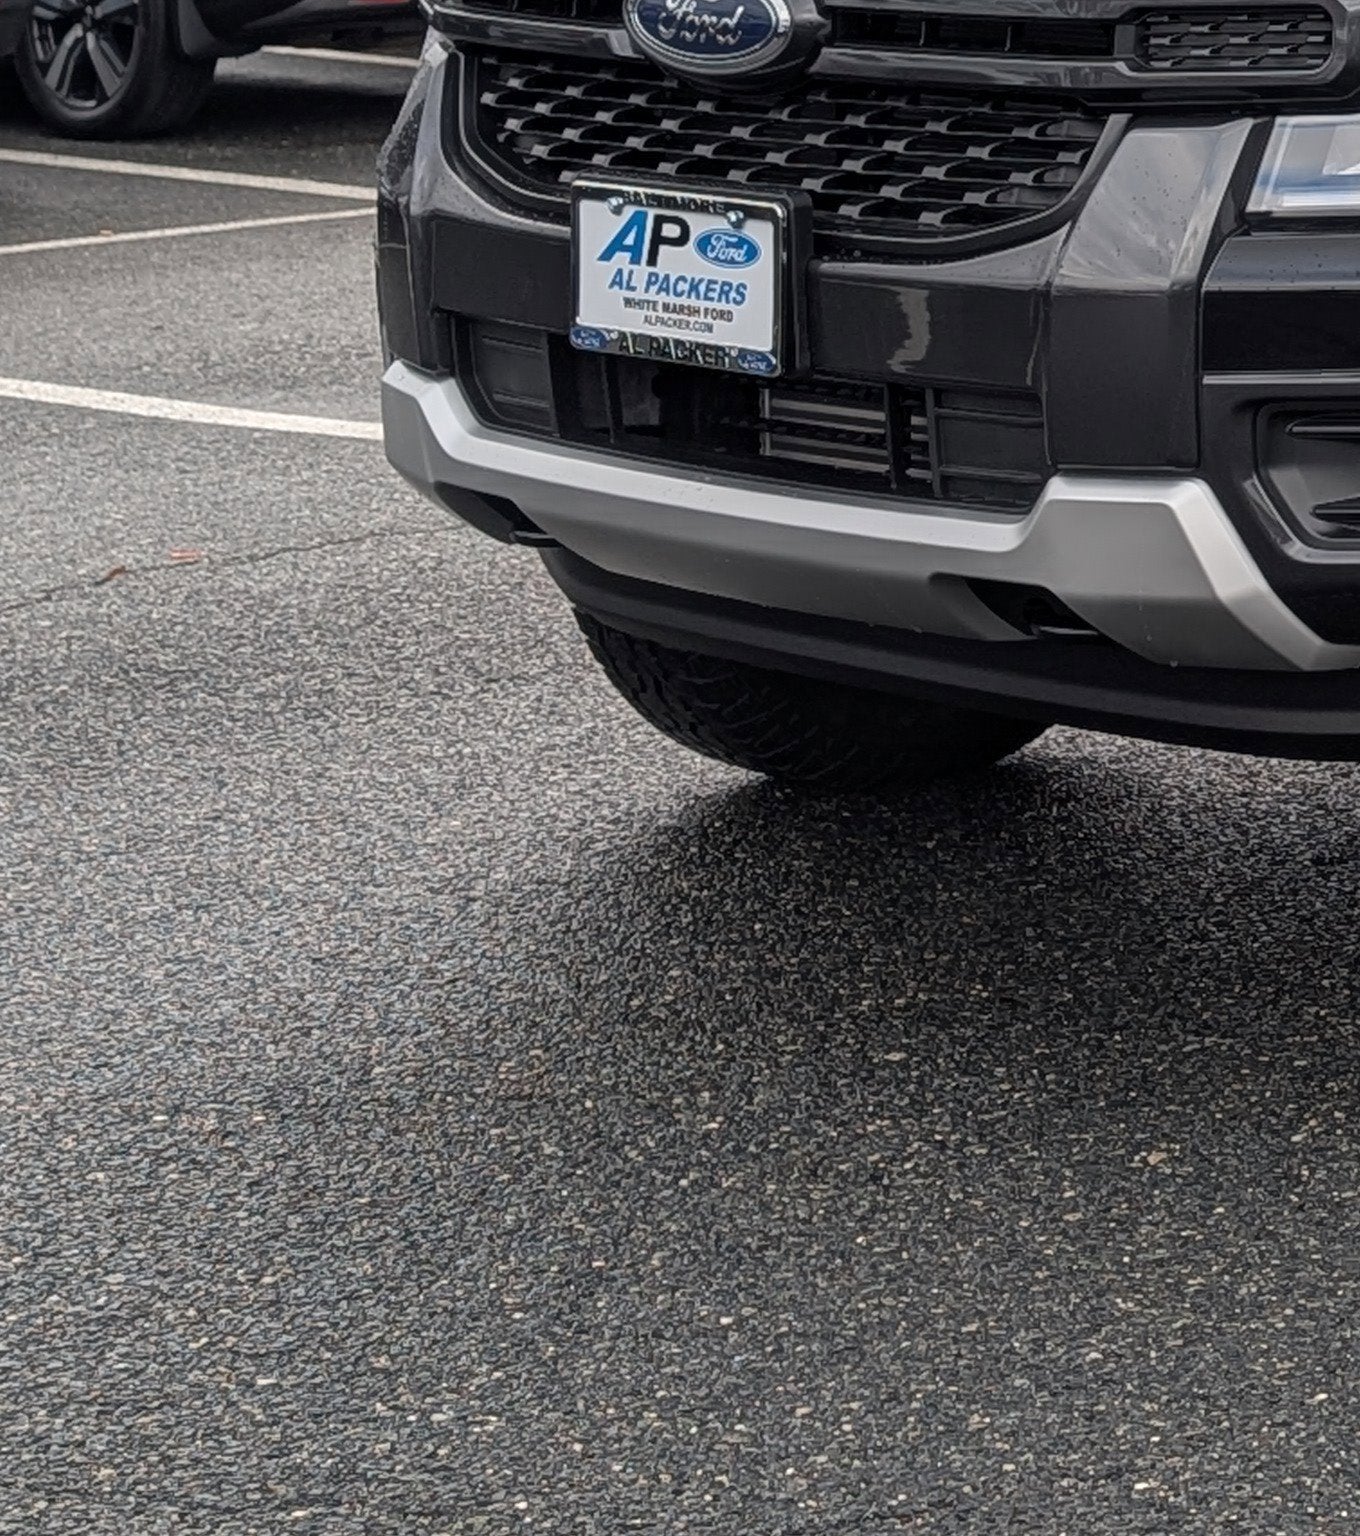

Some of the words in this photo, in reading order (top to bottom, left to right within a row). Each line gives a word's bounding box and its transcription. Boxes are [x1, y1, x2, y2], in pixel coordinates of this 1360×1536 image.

[596, 209, 691, 268] AP
[706, 235, 748, 263] Ford
[608, 267, 638, 292] AL
[643, 271, 748, 306] PACKERS
[622, 296, 660, 314] WHITE
[661, 301, 701, 318] MARSH
[703, 307, 734, 323] FORD
[642, 315, 714, 334] ALPACKER.COM
